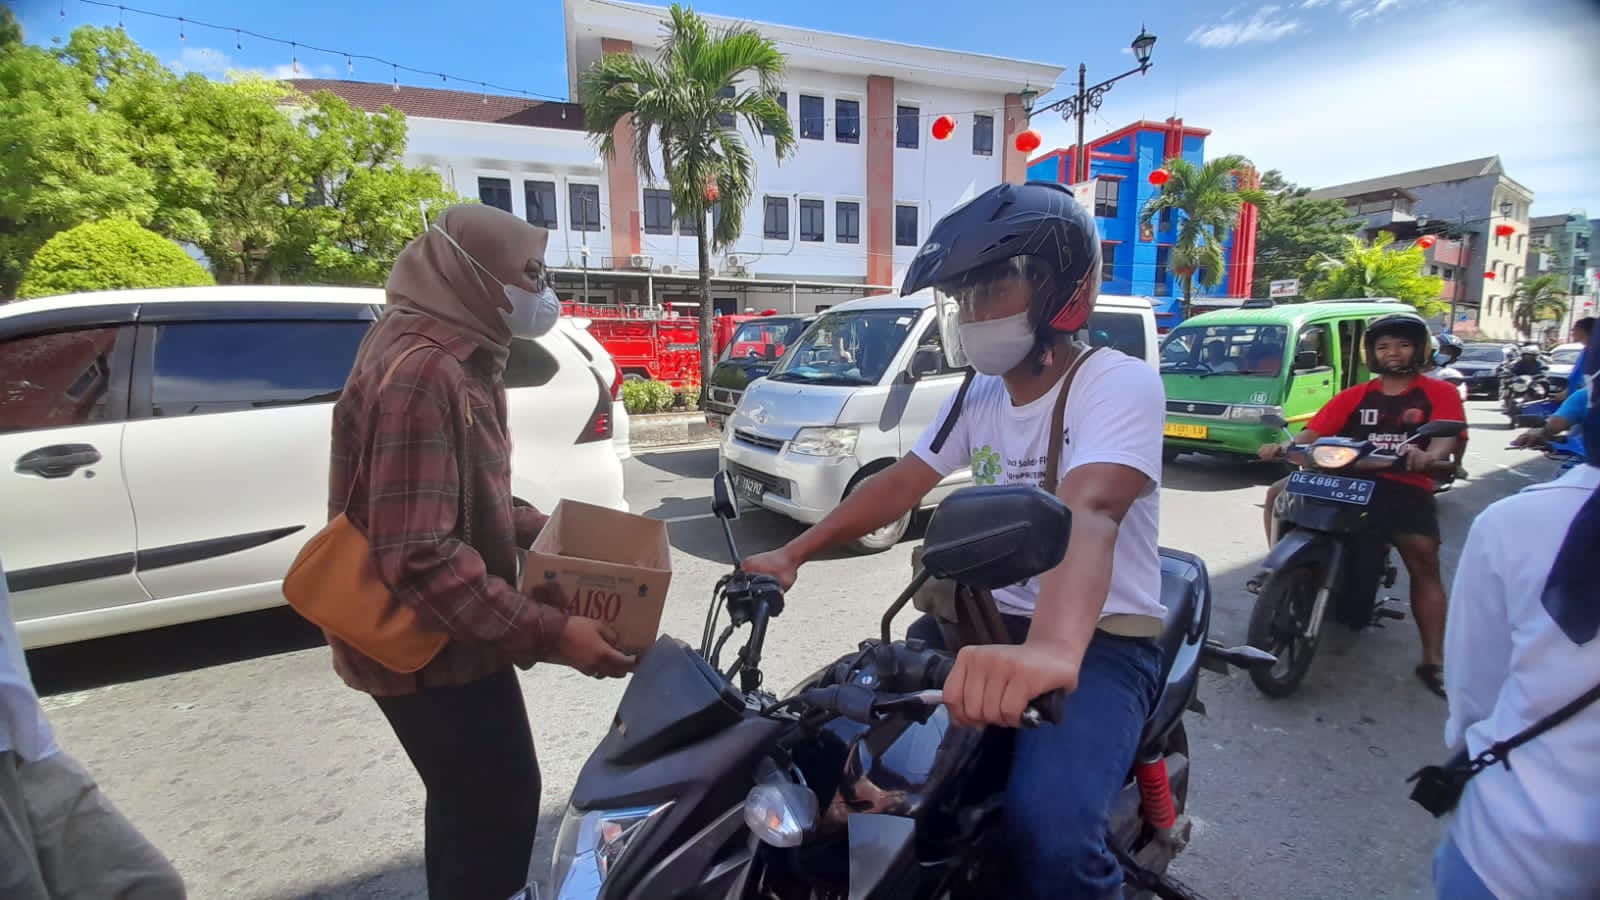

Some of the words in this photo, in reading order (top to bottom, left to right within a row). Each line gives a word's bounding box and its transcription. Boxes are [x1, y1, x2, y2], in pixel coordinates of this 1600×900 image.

[1359, 408, 1379, 425] 10
[1291, 472, 1308, 483] DE
[562, 588, 622, 623] AISO
